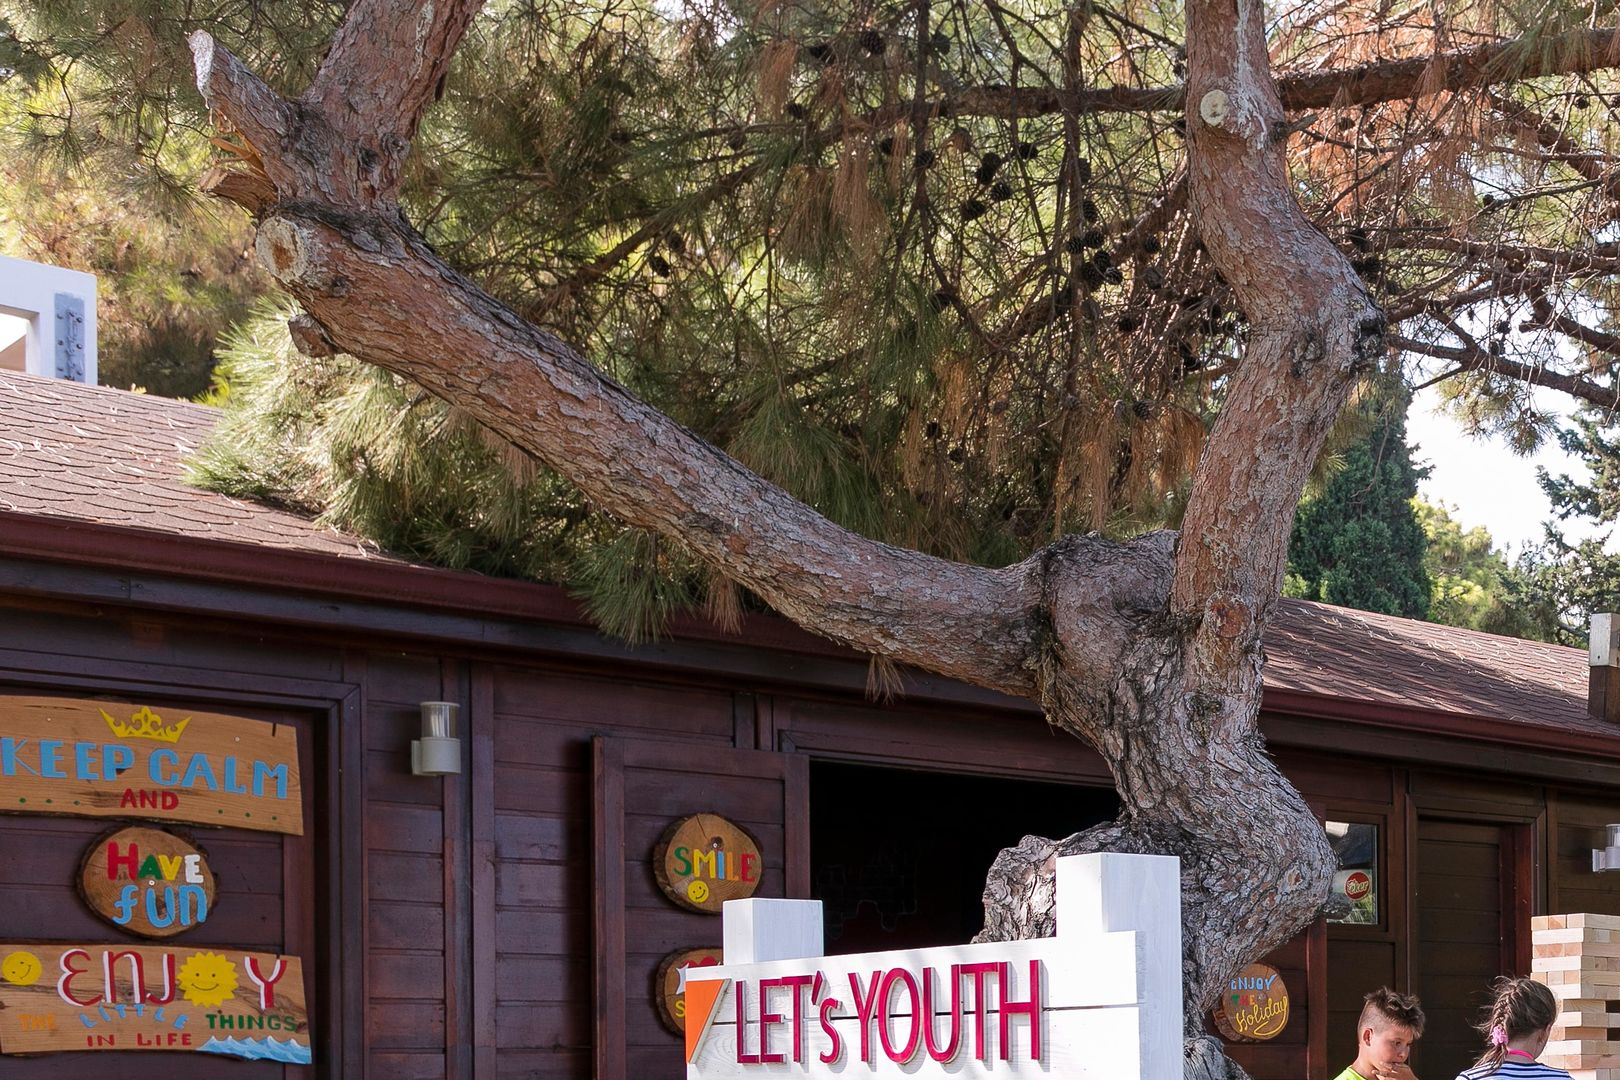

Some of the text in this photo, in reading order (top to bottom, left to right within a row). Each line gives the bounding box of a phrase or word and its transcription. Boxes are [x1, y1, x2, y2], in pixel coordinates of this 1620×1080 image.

[0, 736, 289, 800] KEEP CALM
[120, 788, 180, 811] AND
[106, 841, 205, 885] HAVE
[673, 846, 756, 883] SMILE
[1230, 973, 1277, 991] ENJOY
[79, 1002, 190, 1030] LITTLE
[205, 1013, 299, 1033] THINGS
[848, 959, 1042, 1065] YOUTH
[1235, 995, 1288, 1036] Holiday
[86, 1032, 193, 1047] IN LIFE
